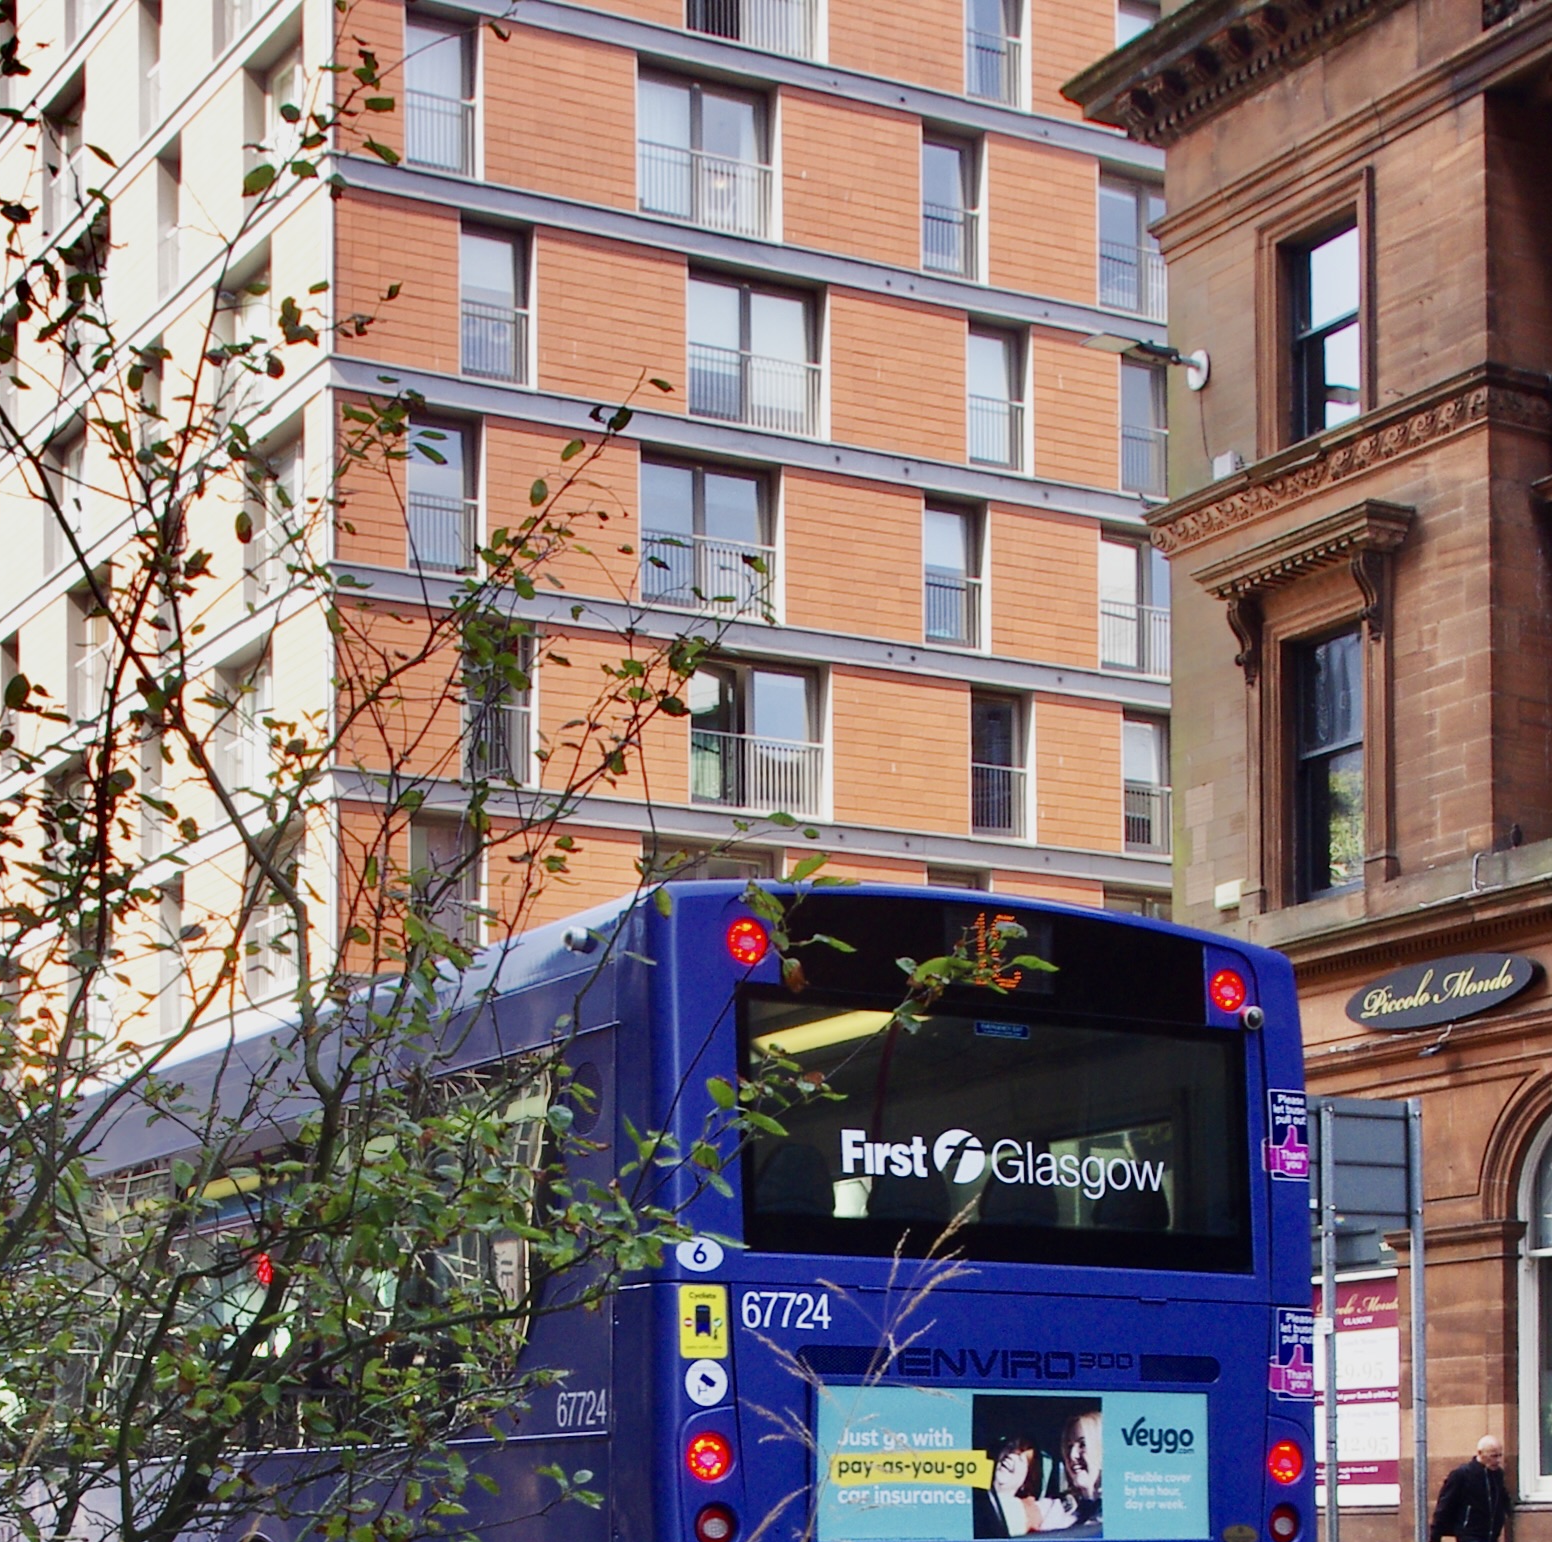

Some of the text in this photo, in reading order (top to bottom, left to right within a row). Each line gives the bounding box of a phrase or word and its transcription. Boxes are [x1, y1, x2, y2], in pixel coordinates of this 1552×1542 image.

[1360, 958, 1514, 1019] Piccolo Mondo
[1277, 1094, 1304, 1105] Please
[1273, 1103, 1284, 1114] let
[1275, 1115, 1291, 1125] pull
[1280, 1149, 1306, 1160] Thank
[841, 1128, 1164, 1200] First Glasgow
[1285, 1161, 1302, 1170] you
[693, 1243, 707, 1264] 6
[688, 1291, 717, 1300] Cyclists
[742, 1290, 832, 1329] 67724
[1343, 1316, 1373, 1326] GLASGOW
[1280, 1323, 1291, 1333] let
[1282, 1334, 1298, 1345] pull
[1286, 1369, 1312, 1380] Thank
[1290, 1380, 1307, 1390] you
[557, 1389, 607, 1427] 67724
[838, 1427, 954, 1451] Just go with
[1121, 1416, 1194, 1453] Veygo
[838, 1460, 977, 1479] pay-as-you-go
[1124, 1472, 1191, 1483] Flexible cover
[838, 1485, 972, 1505] car insurance.
[1124, 1485, 1137, 1497] by
[1139, 1486, 1155, 1496] the
[1125, 1500, 1187, 1511] day or week.
